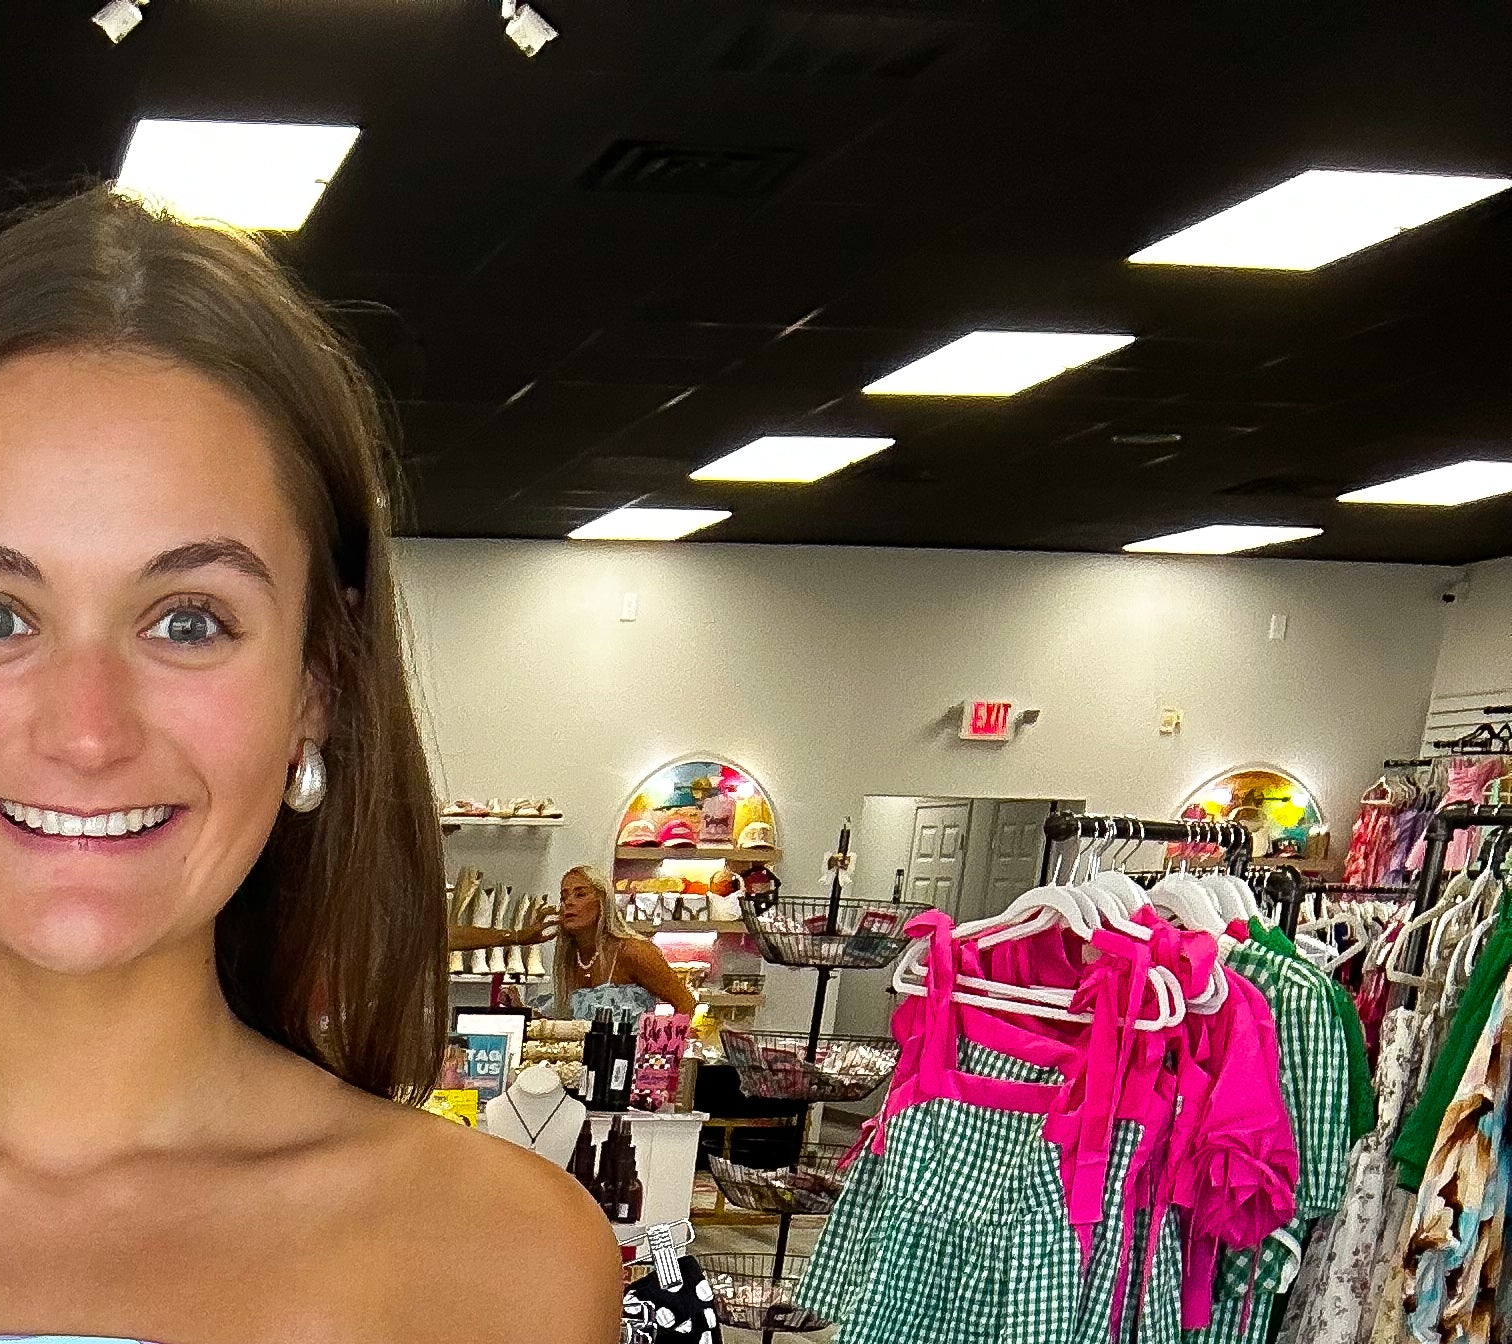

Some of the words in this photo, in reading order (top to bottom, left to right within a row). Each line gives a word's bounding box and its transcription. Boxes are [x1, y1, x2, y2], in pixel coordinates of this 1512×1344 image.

[971, 701, 1012, 734] EXIT
[466, 1048, 502, 1061] TAG
[476, 1062, 502, 1075] US
